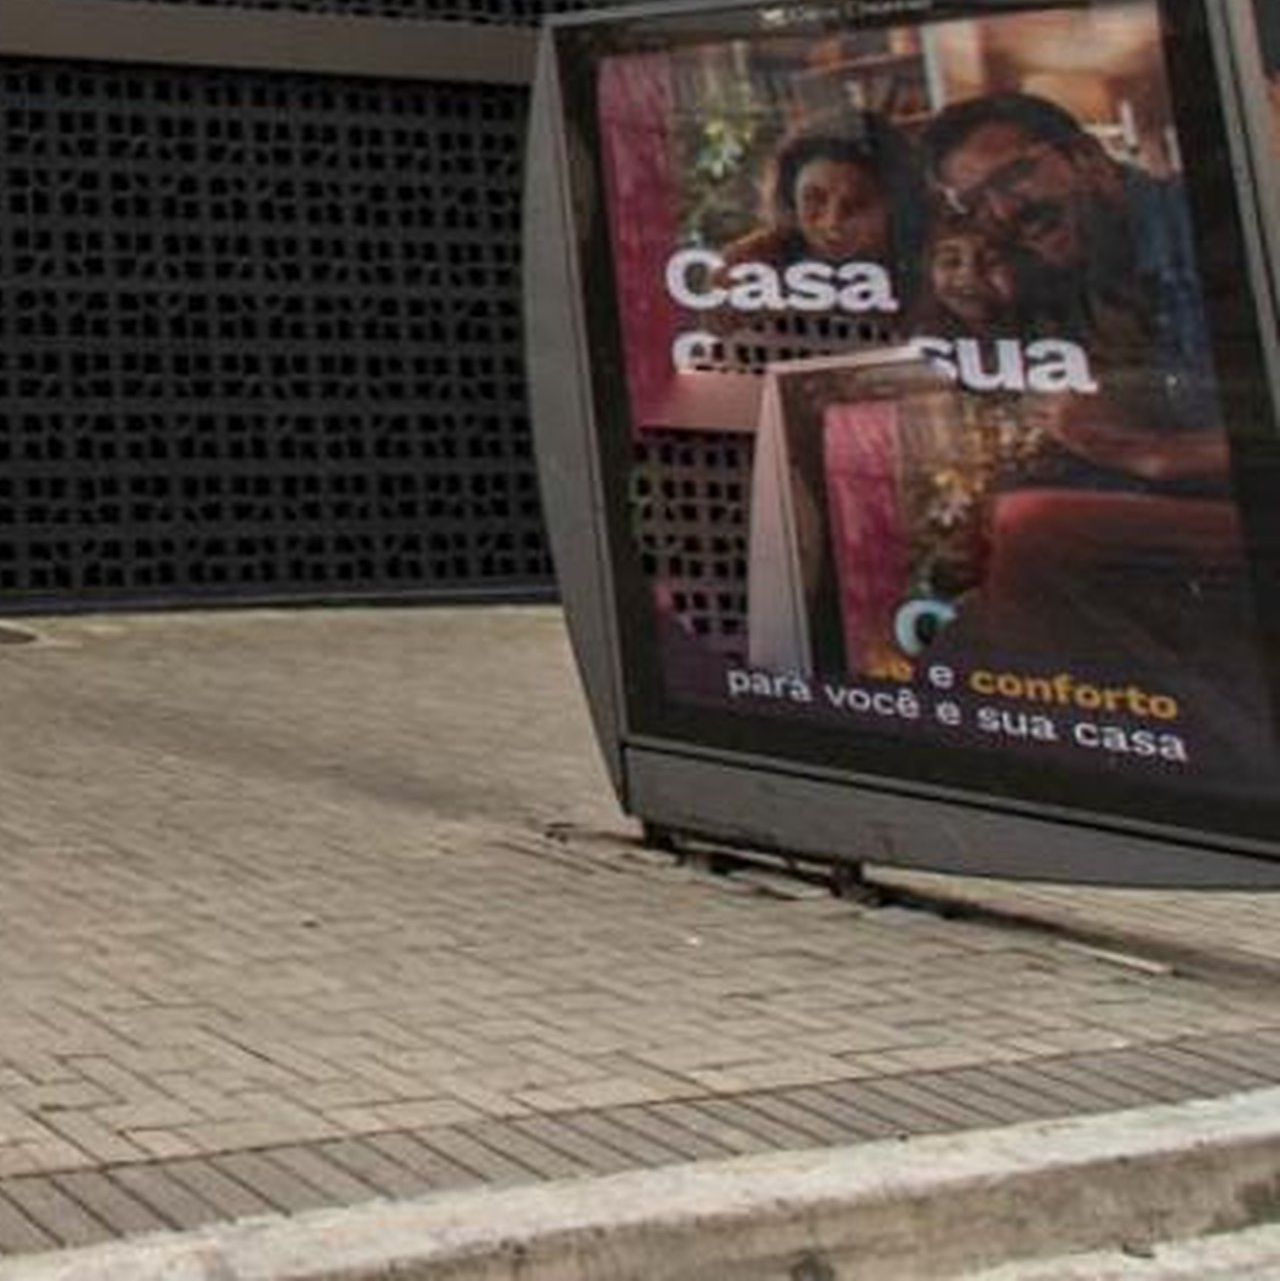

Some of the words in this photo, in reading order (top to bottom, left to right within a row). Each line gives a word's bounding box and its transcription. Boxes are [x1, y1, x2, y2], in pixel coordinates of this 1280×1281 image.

[665, 248, 898, 312] Casa
[727, 670, 812, 703] para
[824, 685, 920, 720] você
[936, 701, 962, 727] e
[977, 705, 1058, 742] sua
[1074, 722, 1187, 762] casa
[928, 665, 954, 690] e
[970, 670, 1179, 720] conforto
